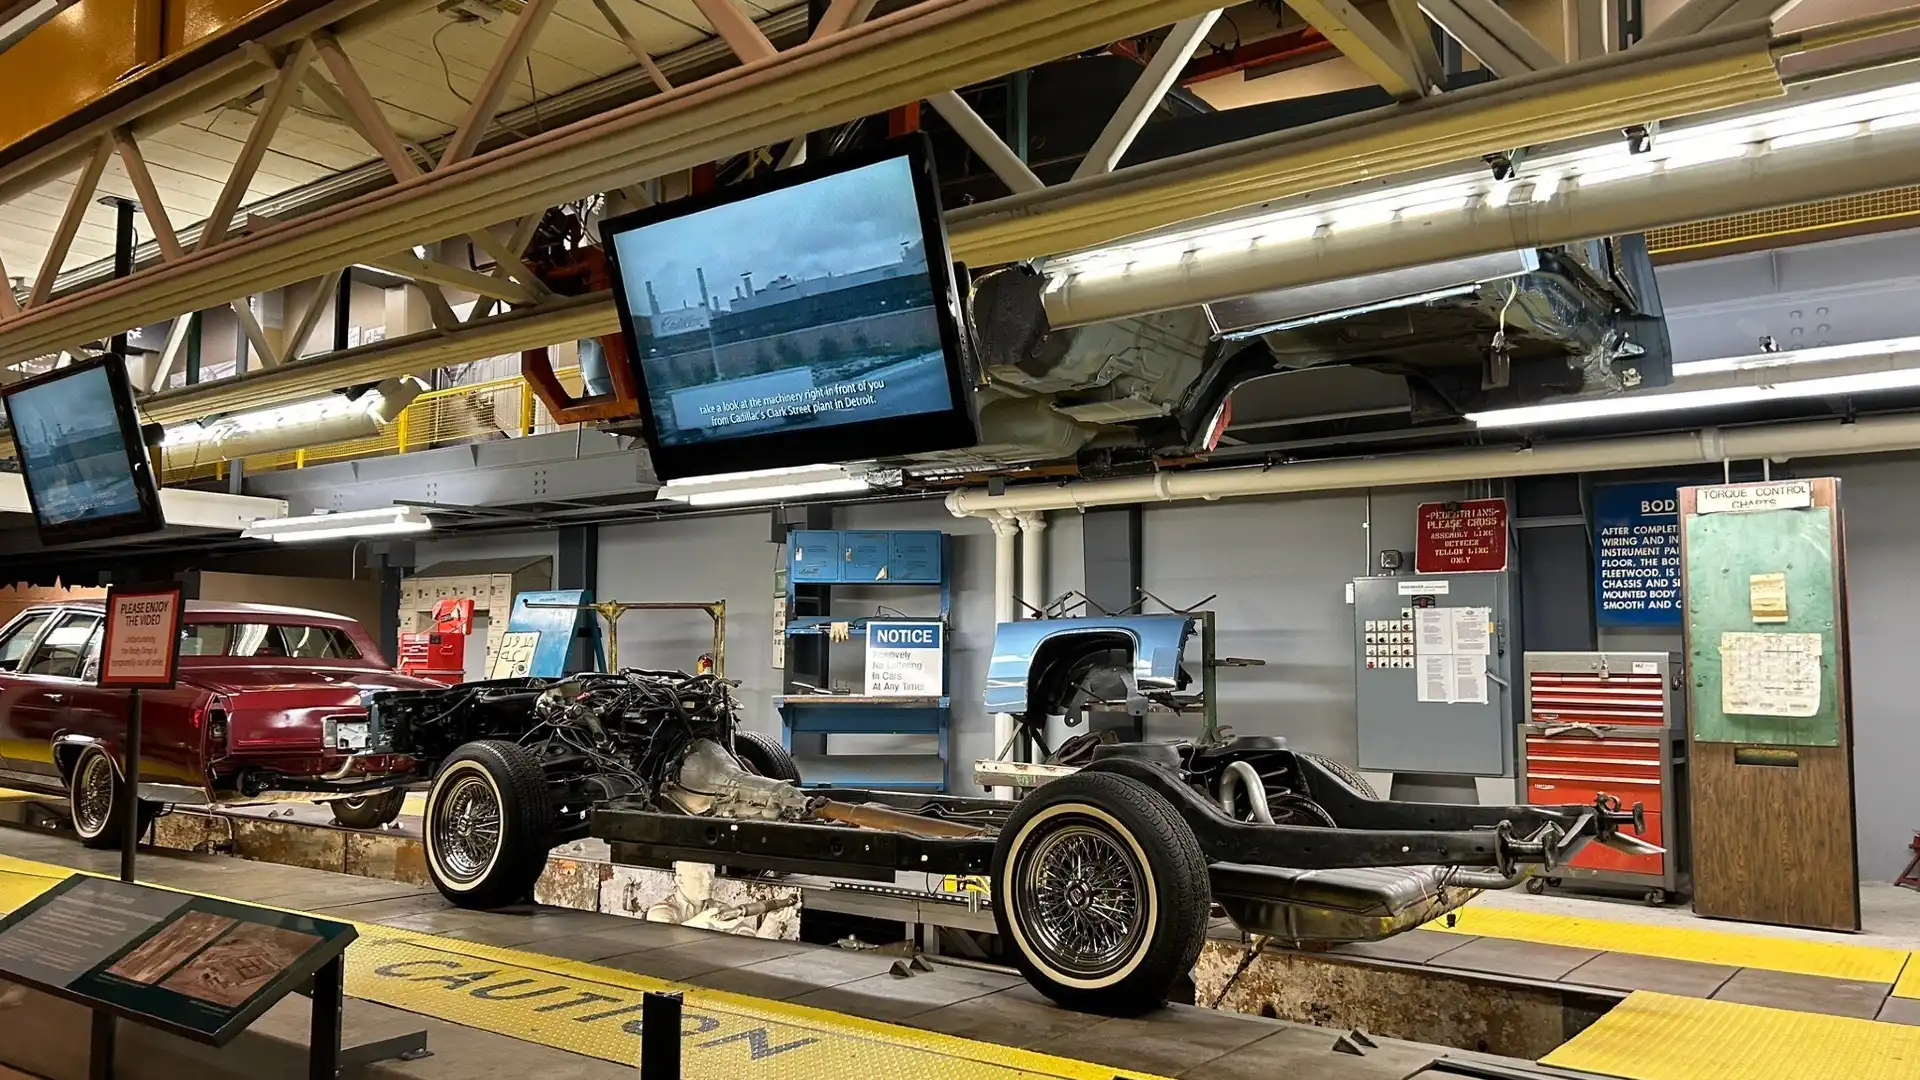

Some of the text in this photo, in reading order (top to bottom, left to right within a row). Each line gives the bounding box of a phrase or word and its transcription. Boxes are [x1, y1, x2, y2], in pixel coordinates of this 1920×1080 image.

[700, 403, 715, 414] take
[723, 400, 740, 411] look
[741, 401, 748, 409] at
[749, 397, 762, 407] the
[763, 392, 803, 406] machinery
[804, 387, 824, 401] right
[825, 386, 834, 396] in
[835, 383, 856, 395] front
[858, 380, 867, 391] of
[867, 380, 885, 392] you
[711, 394, 877, 426] from Cadillac's Clark Street plant in Detroit.
[1703, 485, 1807, 499] TORQUE CONTROL
[1641, 499, 1675, 512] BOD
[1427, 517, 1497, 529] PLEASE CROSS
[1431, 529, 1494, 539] ASSEMBLY LINE
[1601, 525, 1677, 535] AFTER COMPLET
[1445, 539, 1479, 547] BETWEEN
[1602, 535, 1679, 547] WIRING AND IN
[1434, 547, 1489, 556] YELLOW LINE
[1601, 547, 1660, 557] INSTRUMENT
[1450, 556, 1471, 564] ONLY
[1602, 559, 1636, 568] FLOOR,
[1640, 558, 1658, 566] THE
[1666, 568, 1675, 577] IS
[1602, 579, 1642, 589] CHASSIS
[1645, 579, 1668, 588] AND
[1602, 590, 1647, 599] MOUNTED
[1649, 589, 1676, 599] BODY
[121, 601, 169, 614] PLEASE ENJOY
[1603, 600, 1644, 610] SMOOTH
[1648, 600, 1672, 609] AND
[125, 614, 161, 626] THE VIDEO
[877, 629, 933, 643] NOTICE
[872, 672, 902, 681] In Cars
[872, 682, 881, 691] At
[883, 682, 899, 692] Any
[374, 959, 820, 1061] CAUTION
